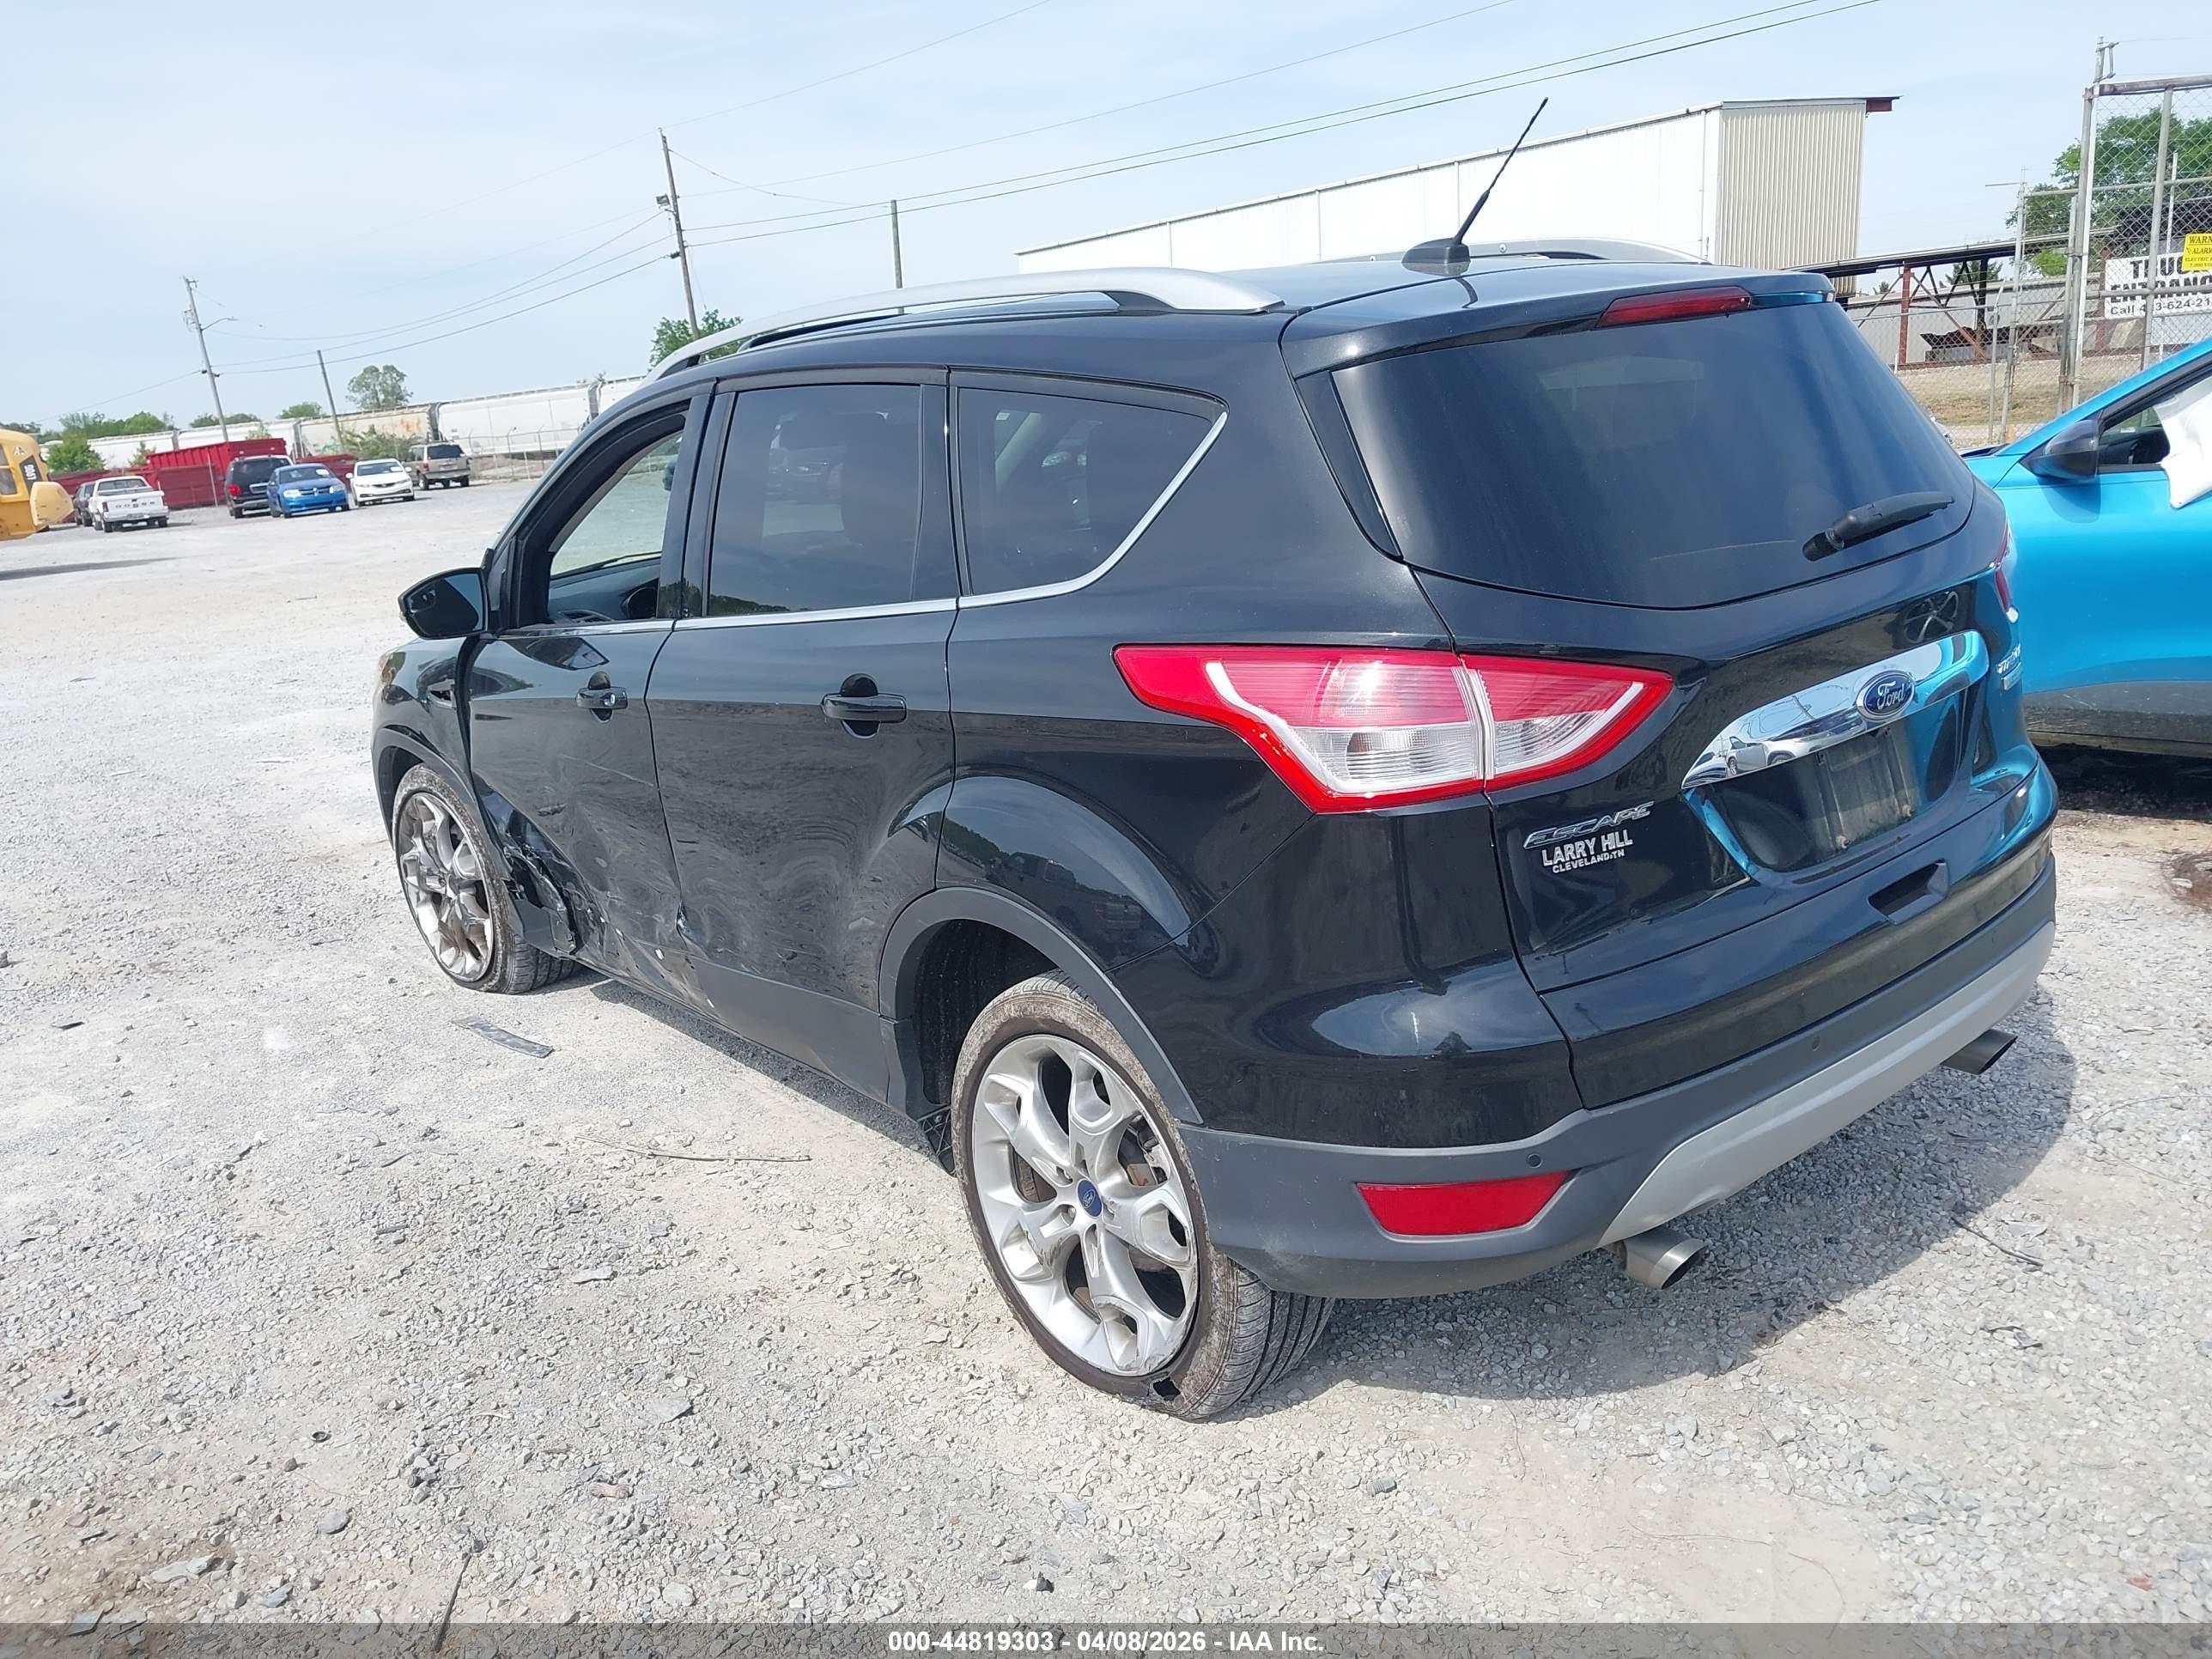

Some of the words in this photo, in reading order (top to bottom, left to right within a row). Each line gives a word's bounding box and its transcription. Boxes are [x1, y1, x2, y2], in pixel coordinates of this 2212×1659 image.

[2111, 305, 2135, 315] Call
[2139, 298, 2212, 313] 43-624-21
[1876, 680, 1905, 710] Ford
[1522, 800, 1656, 851] ESCAPE
[1541, 836, 1596, 866] LARRY
[1601, 829, 1633, 852] HILL
